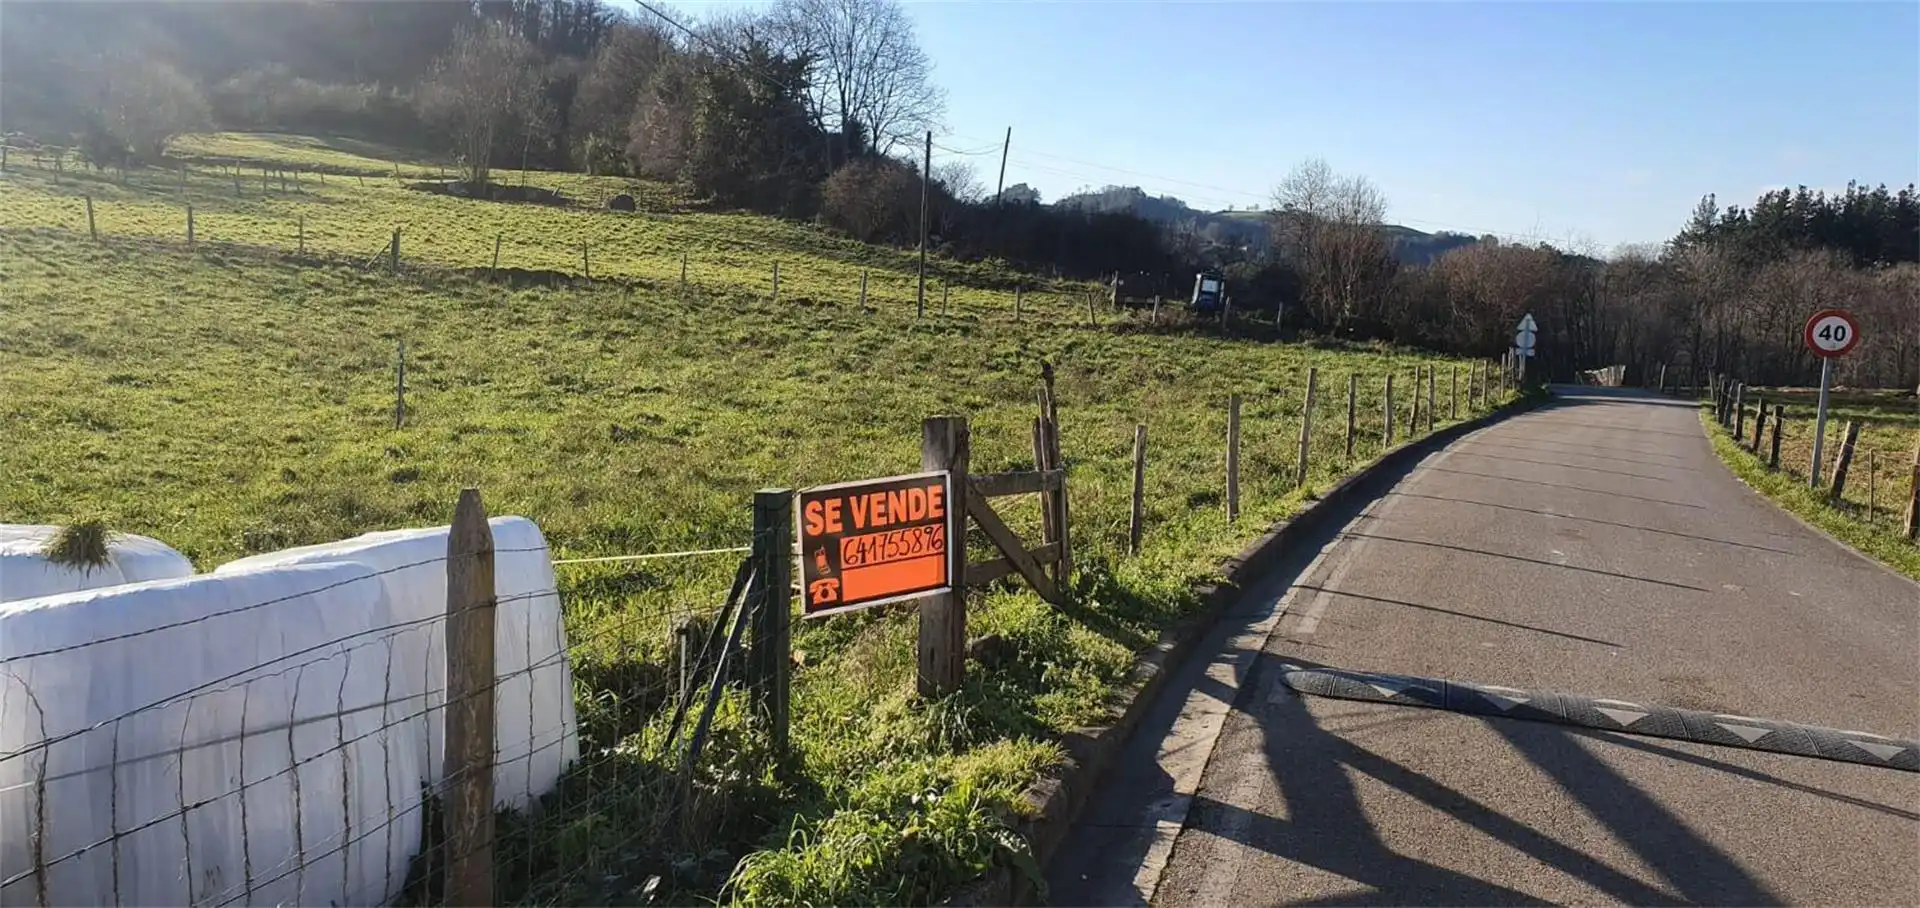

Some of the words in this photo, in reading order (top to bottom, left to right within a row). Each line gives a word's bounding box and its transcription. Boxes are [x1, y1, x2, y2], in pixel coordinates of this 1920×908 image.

[1818, 324, 1846, 342] 40
[805, 498, 843, 536] SE
[849, 484, 944, 529] VENDE
[843, 525, 943, 566] 641755896
